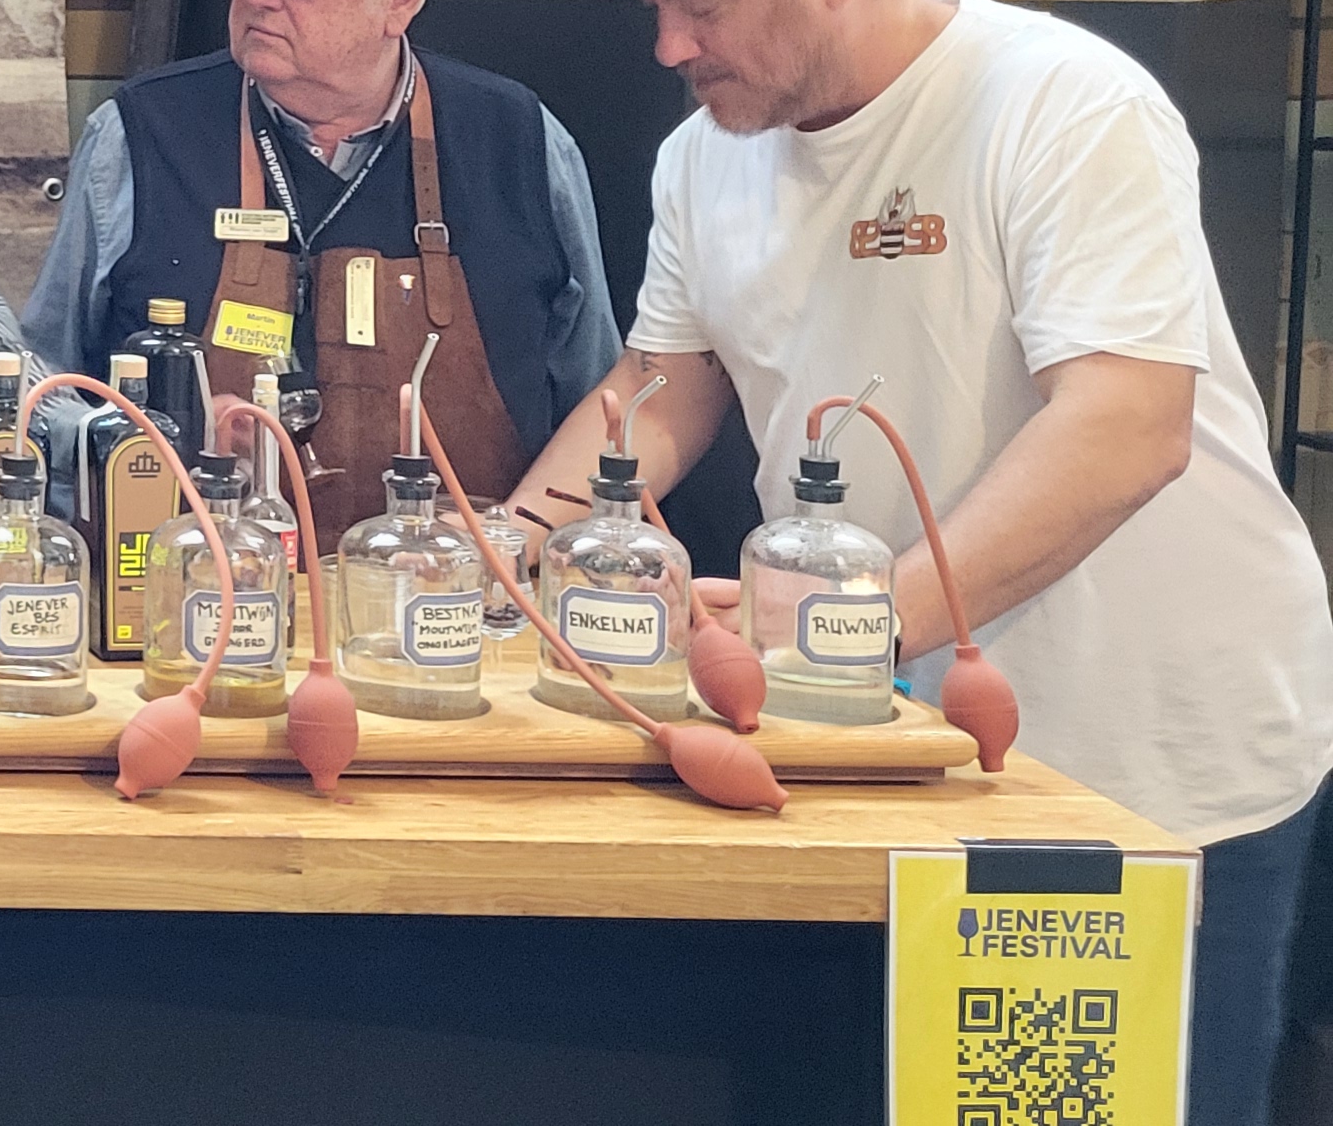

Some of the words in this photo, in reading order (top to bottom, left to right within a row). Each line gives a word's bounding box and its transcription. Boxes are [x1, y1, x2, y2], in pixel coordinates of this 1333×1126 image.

[233, 335, 284, 350] FESTIVA
[235, 328, 286, 343] JENEVER
[7, 597, 68, 615] JENEVER
[569, 611, 654, 634] ENKELNAT
[812, 616, 888, 635] RUWNAT
[982, 908, 1125, 934] JENEVER
[982, 934, 1132, 960] FESTIVAL
